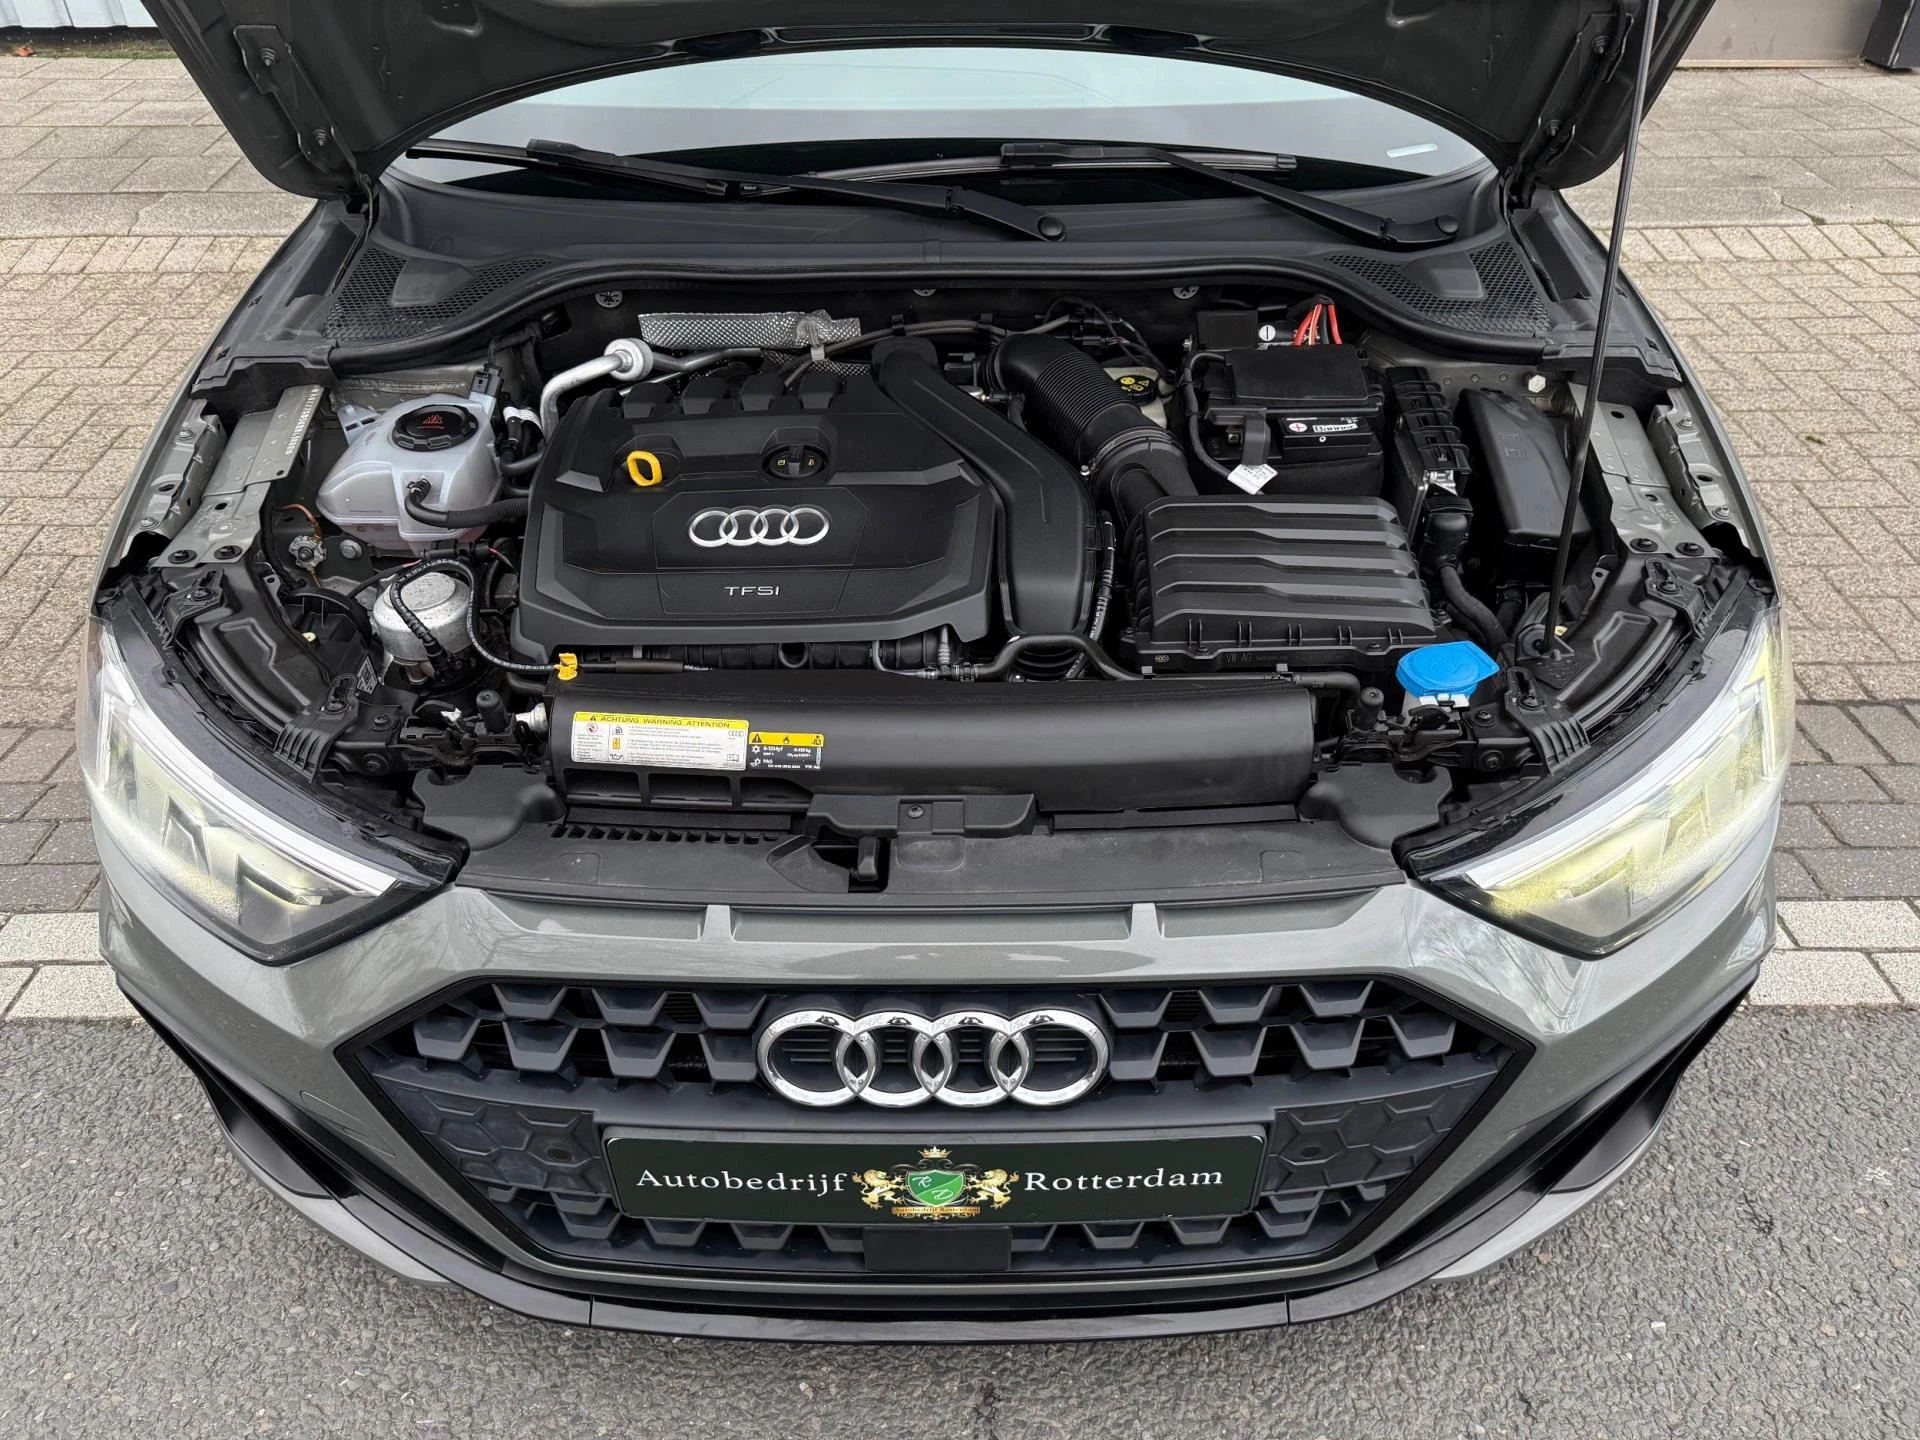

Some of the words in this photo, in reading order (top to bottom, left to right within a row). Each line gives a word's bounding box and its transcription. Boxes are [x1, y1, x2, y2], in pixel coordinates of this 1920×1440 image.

[723, 586, 780, 596] TFSI
[600, 715, 640, 724] ACHTUNG
[643, 718, 683, 726] WARNING
[686, 720, 730, 728] ATTENTION
[636, 1169, 848, 1197] Autobedrijf
[1024, 1168, 1223, 1191] Rotterdam
